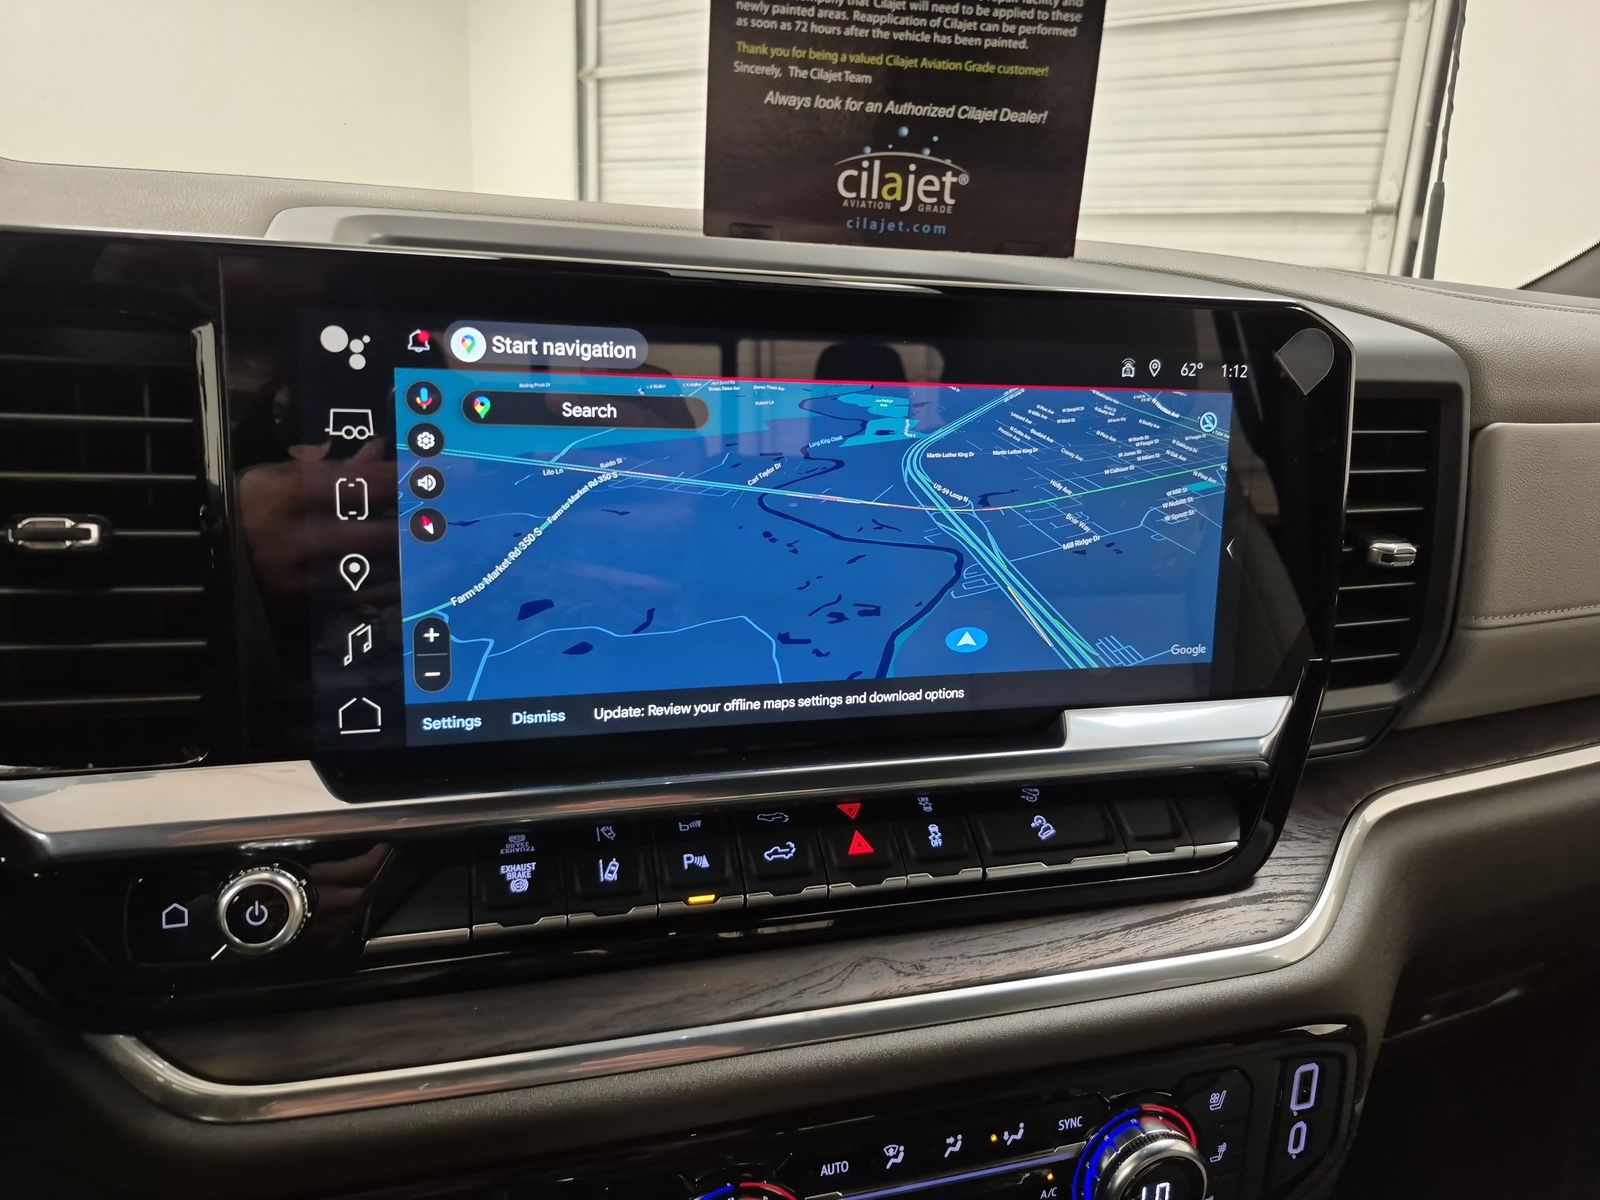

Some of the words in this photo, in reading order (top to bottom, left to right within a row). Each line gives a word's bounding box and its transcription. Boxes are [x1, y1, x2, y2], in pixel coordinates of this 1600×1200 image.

[736, 0, 769, 15] newly
[772, 3, 815, 18] painted
[817, 9, 849, 21] areas.
[853, 10, 927, 27] Reapplication
[929, 17, 940, 28] of
[943, 17, 977, 32] Cilajet
[979, 21, 999, 33] can
[1002, 21, 1016, 34] be
[1018, 23, 1077, 37] performed
[909, 0, 929, 12] will
[931, 2, 959, 15] need
[961, 4, 974, 16] to
[976, 4, 990, 17] be
[992, 7, 1035, 21] applied
[1037, 10, 1050, 21] to
[1051, 10, 1083, 23] these
[736, 17, 748, 27] as
[750, 19, 777, 30] soon
[780, 21, 792, 32] as
[795, 21, 808, 33] 72
[810, 22, 841, 36] hours
[843, 25, 869, 38] after
[872, 27, 890, 40] the
[892, 30, 930, 43] vehicle
[933, 32, 952, 44] has
[954, 33, 982, 47] been
[984, 36, 1029, 50] painted.
[736, 41, 768, 56] Thank
[770, 47, 790, 59] you
[791, 46, 806, 59] for
[808, 48, 839, 64] being
[840, 54, 847, 63] a
[849, 53, 883, 66] valued
[885, 54, 918, 70] Cilajet
[920, 57, 962, 71] Aviation
[964, 60, 996, 74] Grade
[997, 65, 1049, 77] customer!
[733, 60, 782, 79] Sincerely,
[789, 66, 808, 79] The
[810, 67, 842, 83] Cilajet
[844, 70, 873, 84] Team
[764, 90, 811, 110] Always
[814, 94, 842, 111] look
[844, 96, 865, 112] for
[865, 101, 882, 113] an
[884, 100, 955, 118] Authorized
[957, 105, 998, 123] Cilajet
[1000, 107, 1049, 124] Dealer!
[842, 199, 891, 210] AVIATION
[917, 203, 953, 214] GRADE
[846, 217, 946, 234] cilajet.com
[492, 335, 539, 356] Start
[542, 338, 637, 361] navigation
[1221, 364, 1248, 378] 1:12
[562, 401, 617, 419] Search
[1074, 454, 1084, 462] Ave
[758, 466, 775, 478] Taylor
[774, 462, 782, 470] Dr
[934, 482, 950, 496] US-59
[950, 490, 964, 502] Loop
[1050, 478, 1064, 491] Holly
[1062, 487, 1073, 496] Ave
[546, 508, 564, 524] Farm
[562, 501, 570, 512] to
[568, 484, 590, 505] Market
[588, 478, 598, 489] Rd
[598, 472, 612, 484] 350
[1186, 496, 1194, 504] St
[1066, 513, 1079, 526] Briar
[1078, 522, 1091, 533] Way
[1164, 514, 1172, 522] W
[1074, 538, 1094, 548] Ridge
[450, 588, 476, 607] Farm
[474, 581, 485, 594] to
[482, 558, 511, 586] Market
[508, 546, 522, 562] Rd
[518, 532, 537, 551] 350
[534, 526, 543, 537] S
[1170, 644, 1207, 658] Google
[593, 705, 645, 722] Update:
[648, 703, 692, 717] Review
[693, 702, 721, 717] your
[723, 697, 761, 712] offline
[763, 697, 795, 711] maps
[797, 694, 843, 708] settings
[845, 692, 866, 705] and
[868, 688, 923, 703] download
[925, 687, 965, 702] options
[422, 715, 482, 732] Settings
[512, 710, 566, 725] Dismiss
[930, 838, 943, 848] OFF
[500, 862, 536, 874] EXHAUST
[506, 870, 532, 881] BRAKE
[1058, 1116, 1083, 1131] SYNC
[820, 1160, 849, 1177] AUTO
[1040, 1187, 1057, 1200] A/C
